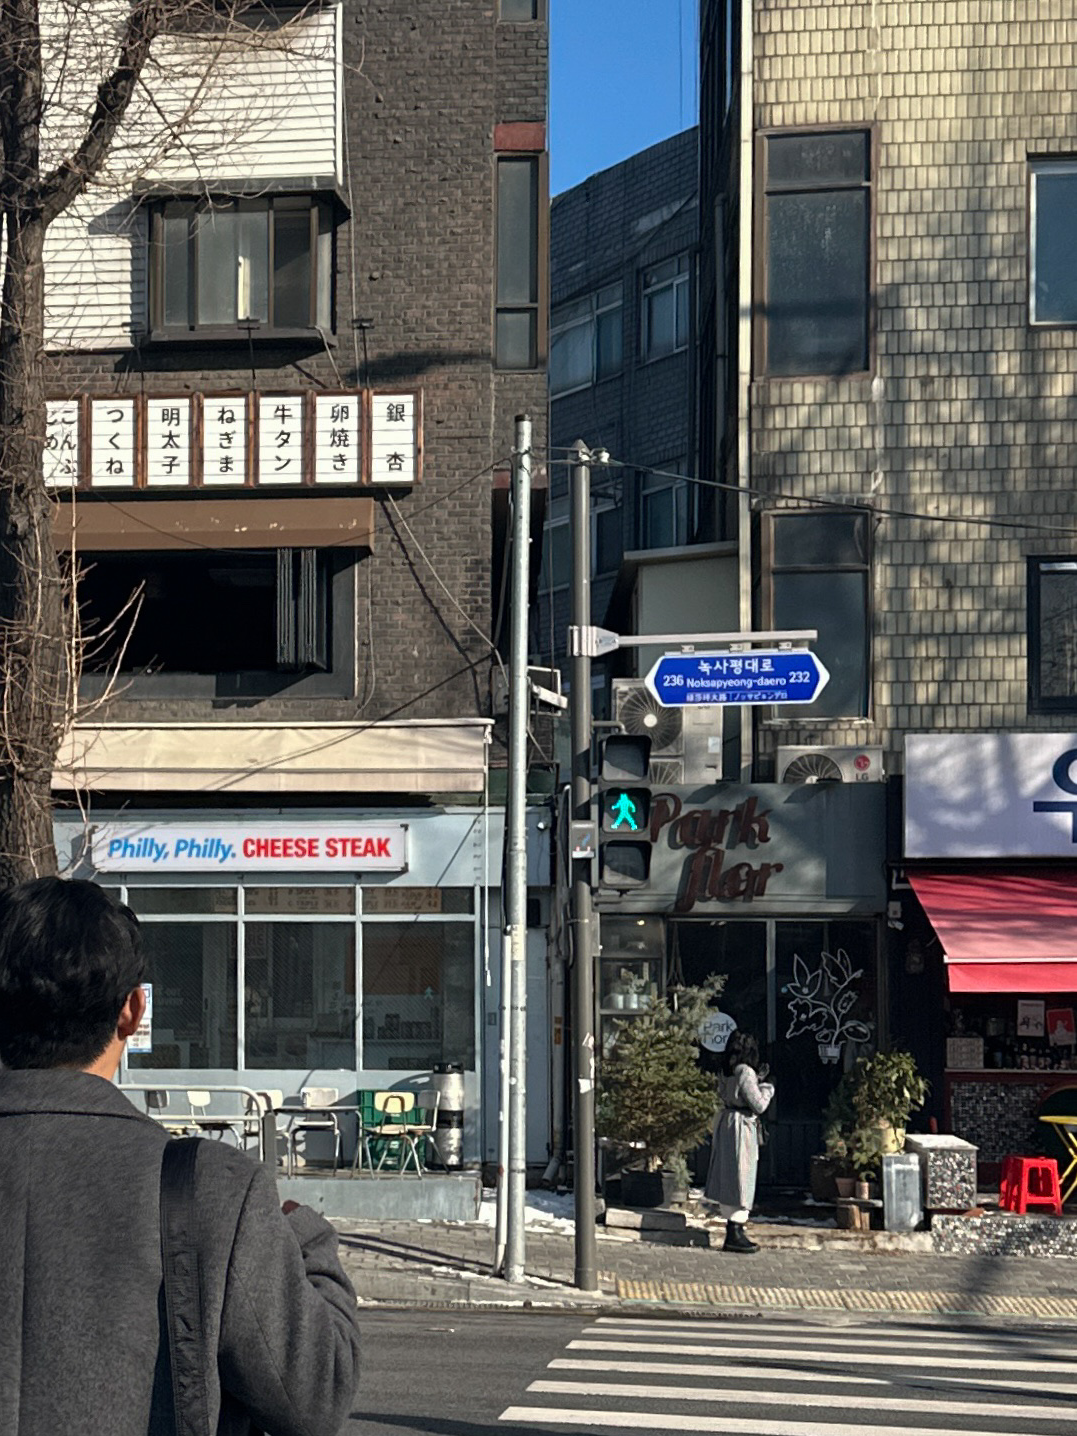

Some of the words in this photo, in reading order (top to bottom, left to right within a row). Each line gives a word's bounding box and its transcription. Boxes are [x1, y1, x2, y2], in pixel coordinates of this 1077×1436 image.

[106, 408, 124, 475] つくね
[161, 407, 181, 474] 明太子
[217, 406, 236, 473] ねぎま
[274, 404, 293, 472] 牛タン
[330, 403, 350, 471] 卵焼き
[386, 402, 405, 472] 銀杏
[663, 675, 685, 687] 236
[686, 674, 787, 690] Noksapyeong-daero
[697, 658, 775, 676] 녹사평대로
[788, 671, 810, 684] 232
[650, 792, 772, 843] Park
[107, 838, 170, 863] Philly,
[174, 838, 237, 863] Philly.
[243, 838, 319, 858] CHEESE
[325, 837, 392, 858] STEAK
